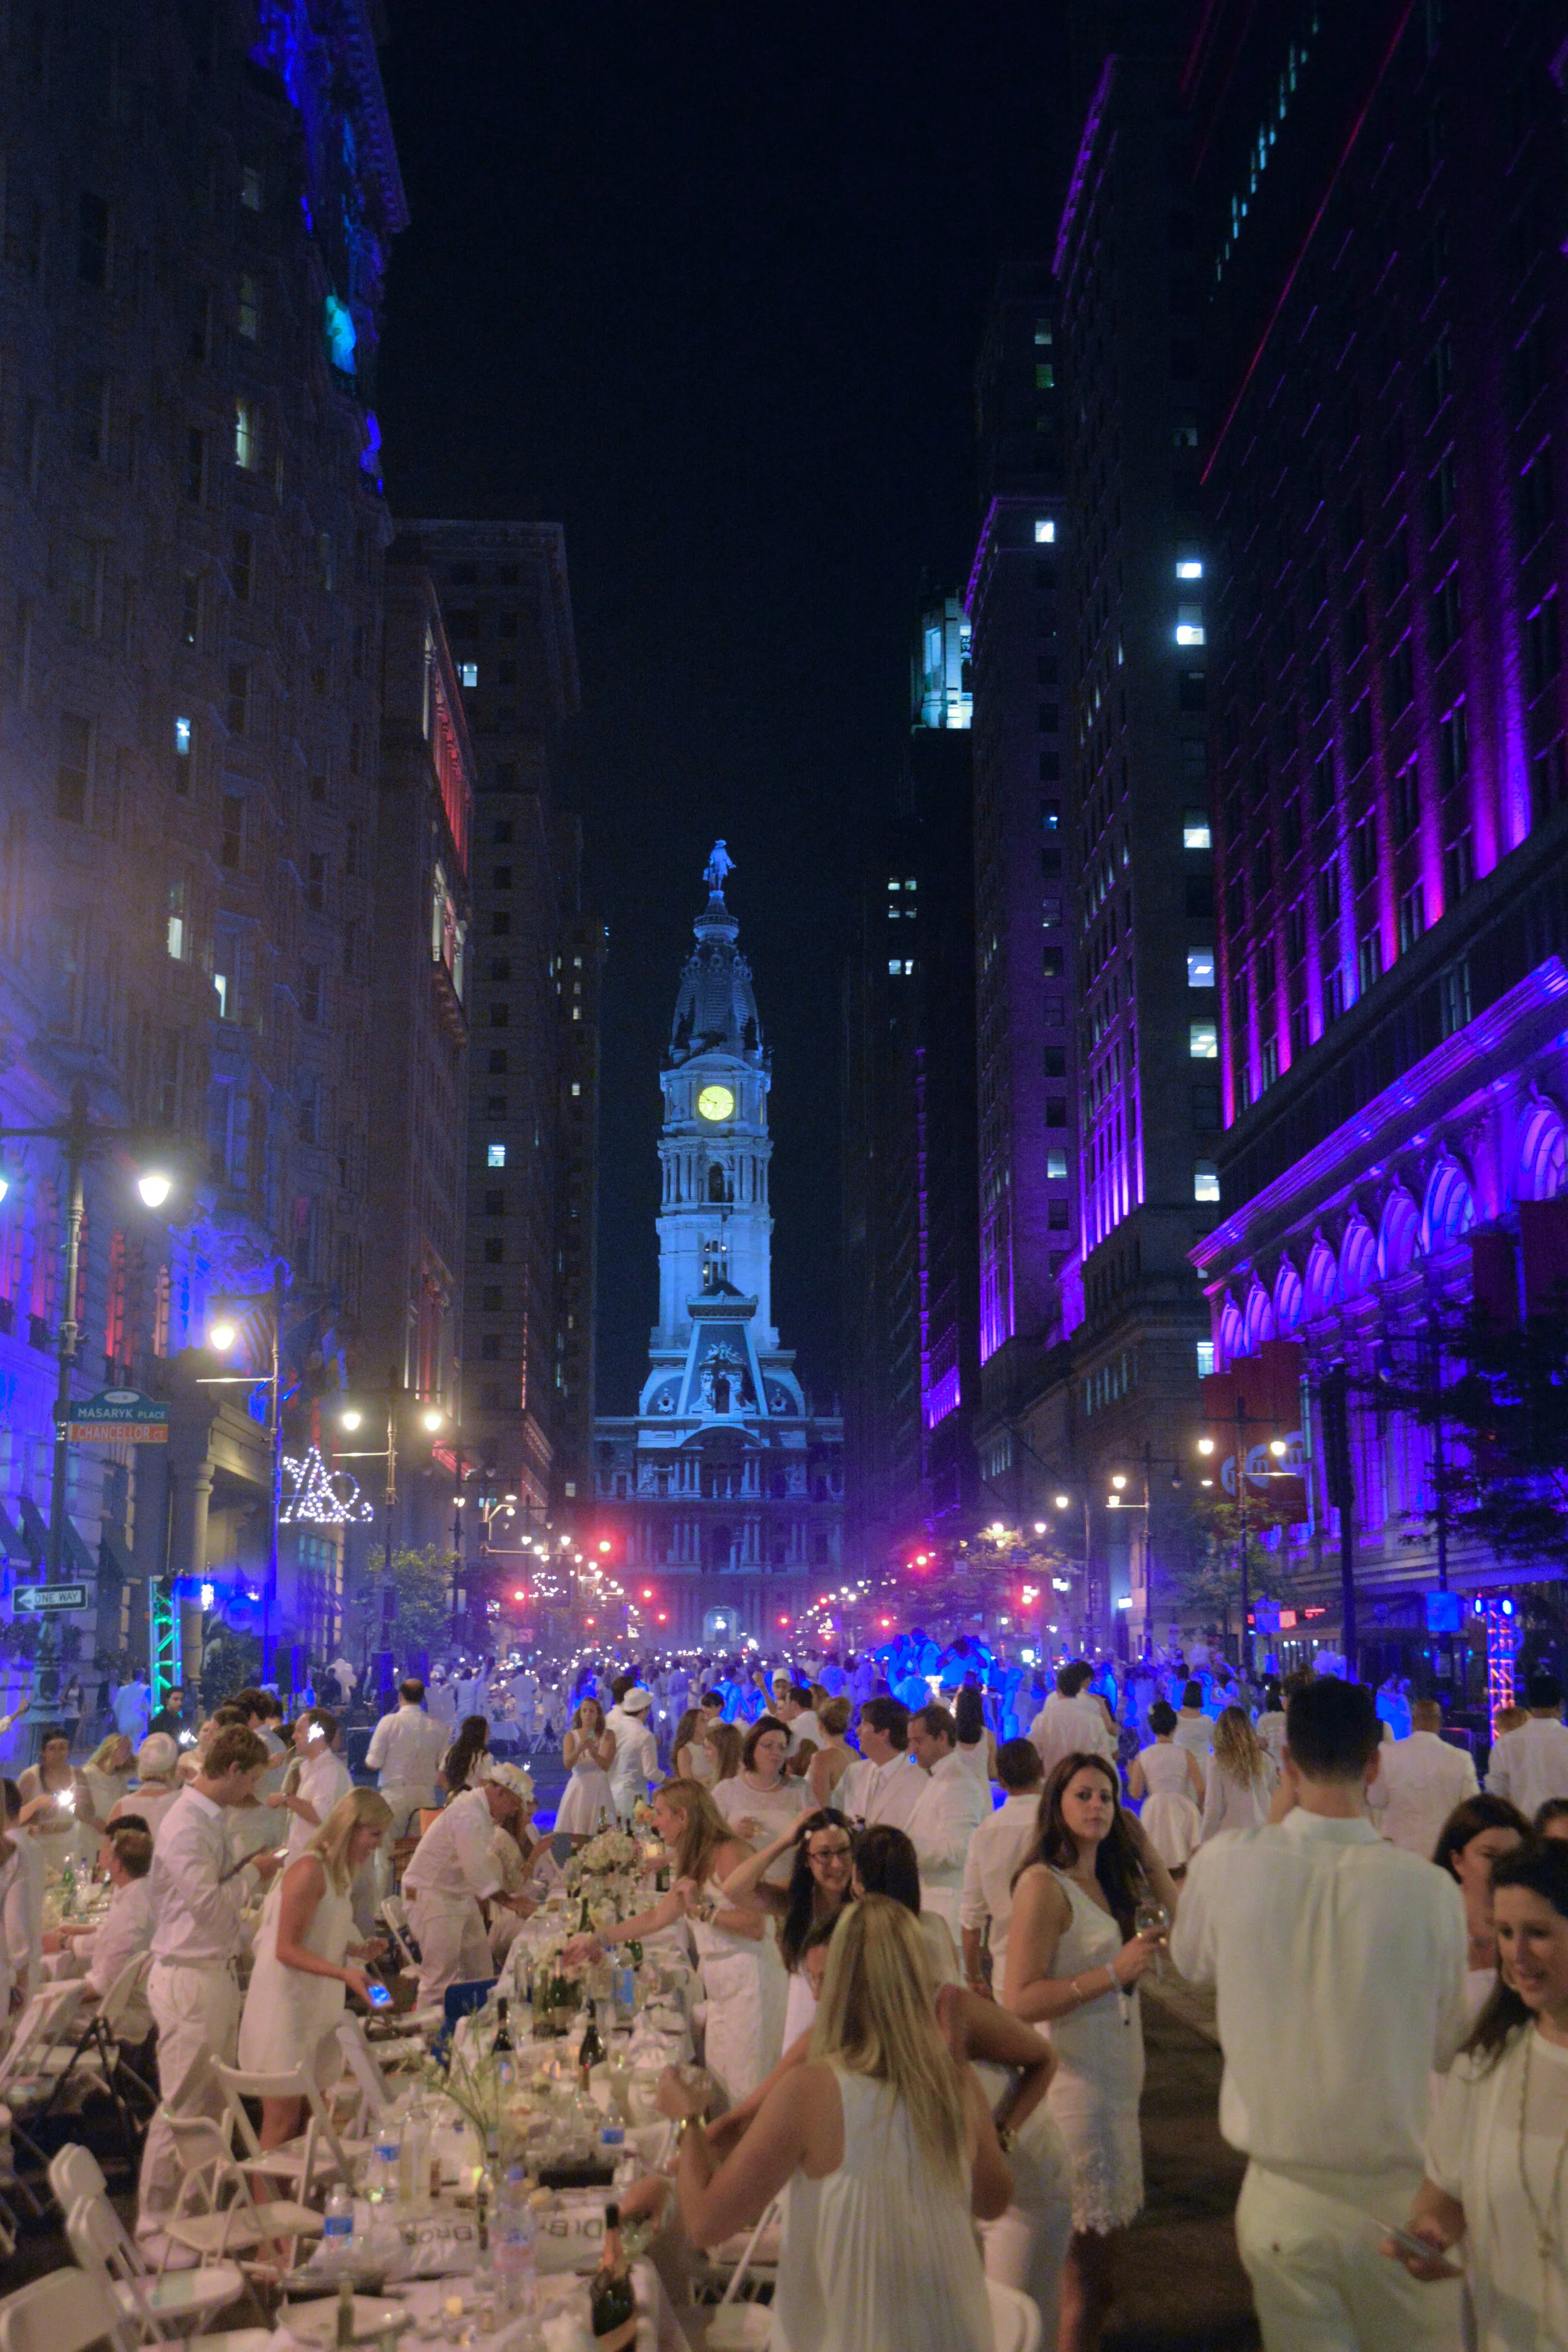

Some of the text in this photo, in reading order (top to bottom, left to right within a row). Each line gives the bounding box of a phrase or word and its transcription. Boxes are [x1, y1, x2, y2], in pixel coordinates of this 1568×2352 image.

[77, 1408, 166, 1419] MASARYK PLACE
[77, 1425, 164, 1440] CHANCELLOR CT
[34, 1592, 55, 1604] ONE
[58, 1591, 78, 1602] WAY
